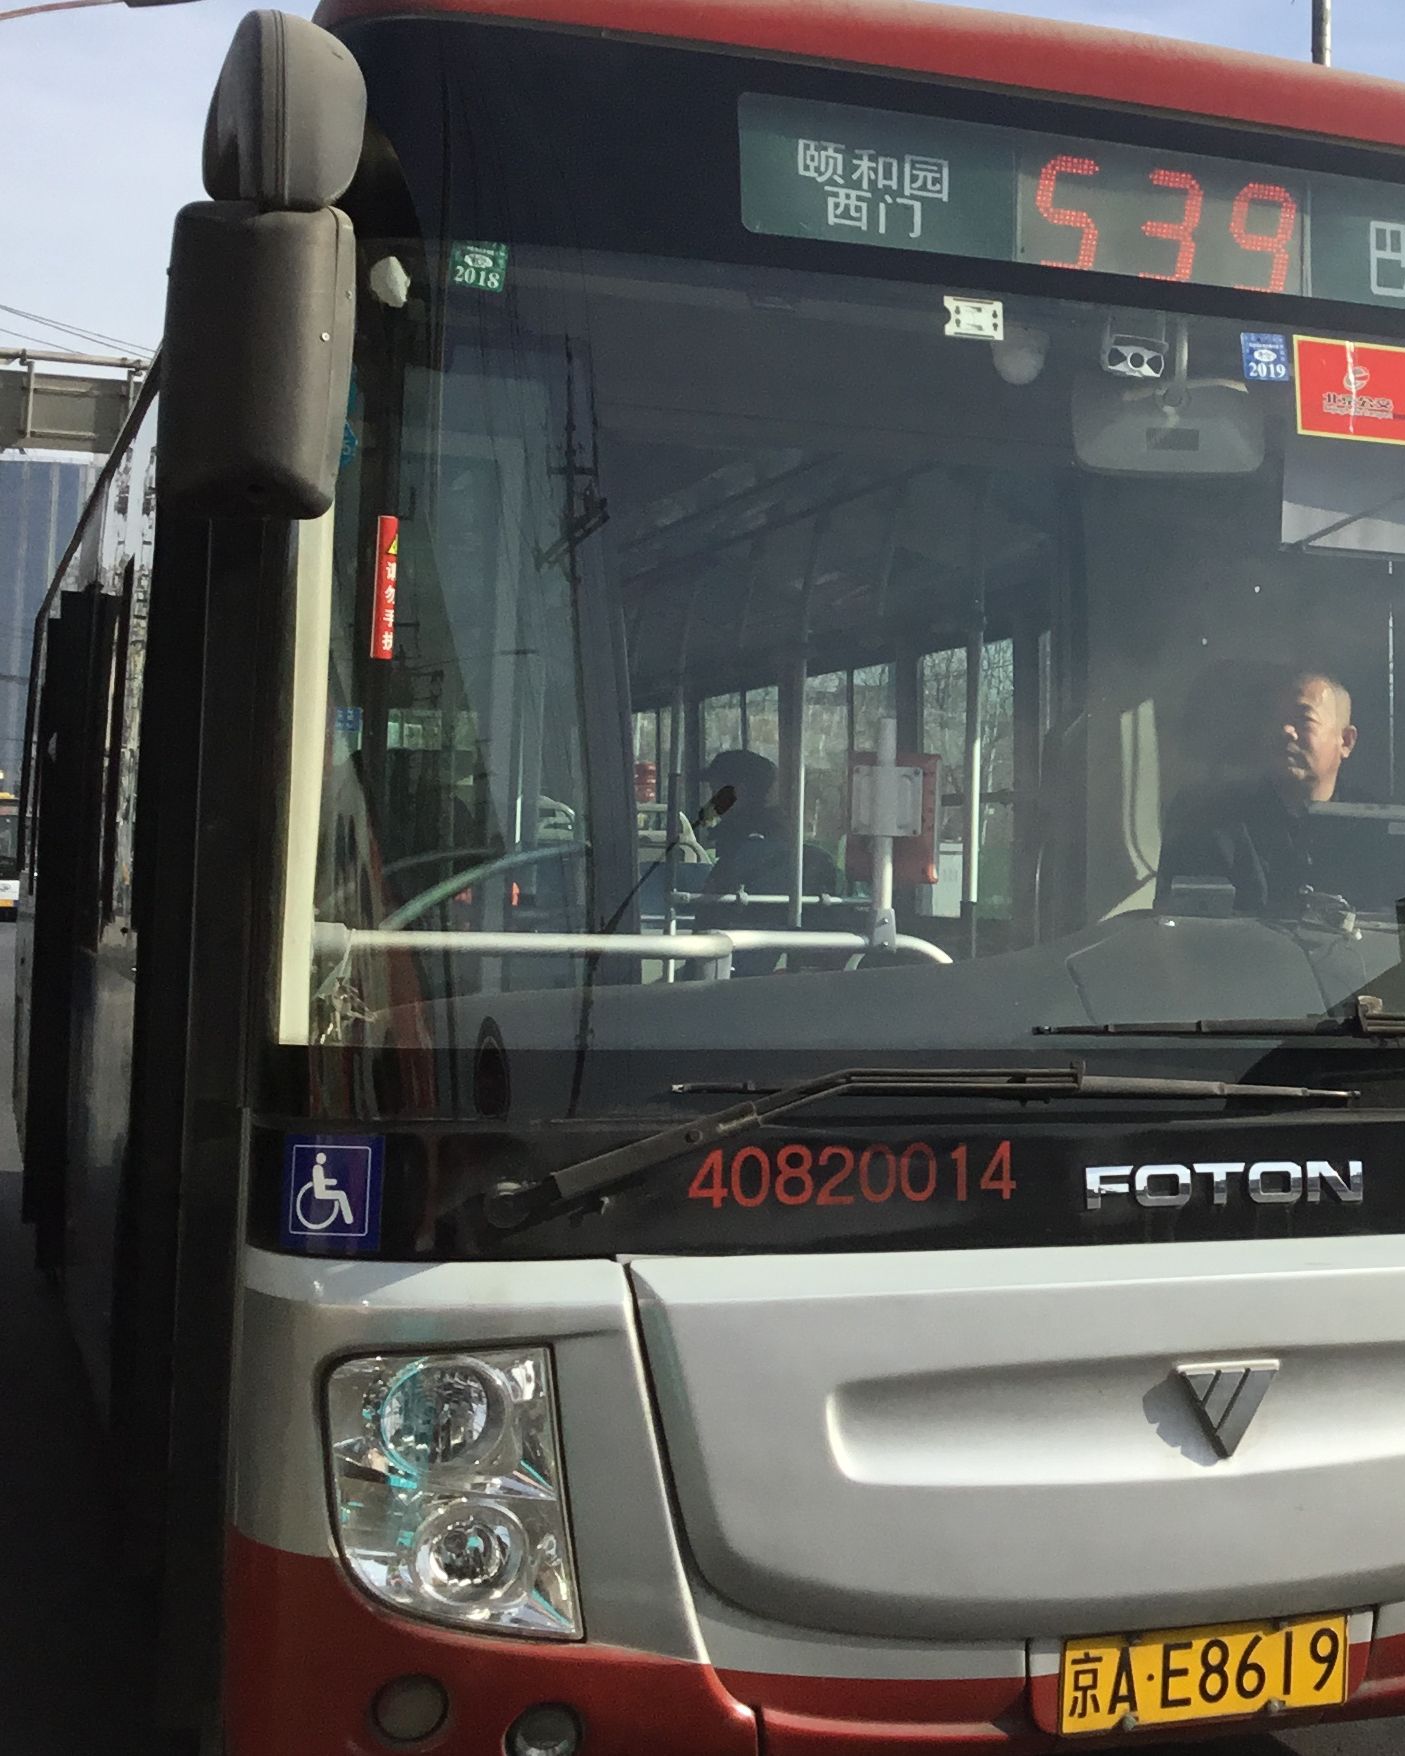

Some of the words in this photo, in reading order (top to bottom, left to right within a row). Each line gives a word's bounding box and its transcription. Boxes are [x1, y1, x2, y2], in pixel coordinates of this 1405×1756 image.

[796, 137, 950, 202] 颐和园
[823, 186, 924, 238] 西门
[1034, 153, 1299, 295] 539
[454, 265, 500, 288] 2018
[1248, 361, 1286, 378] 2019
[688, 1140, 1017, 1209] 40820014
[1086, 1160, 1363, 1211] FOTON
